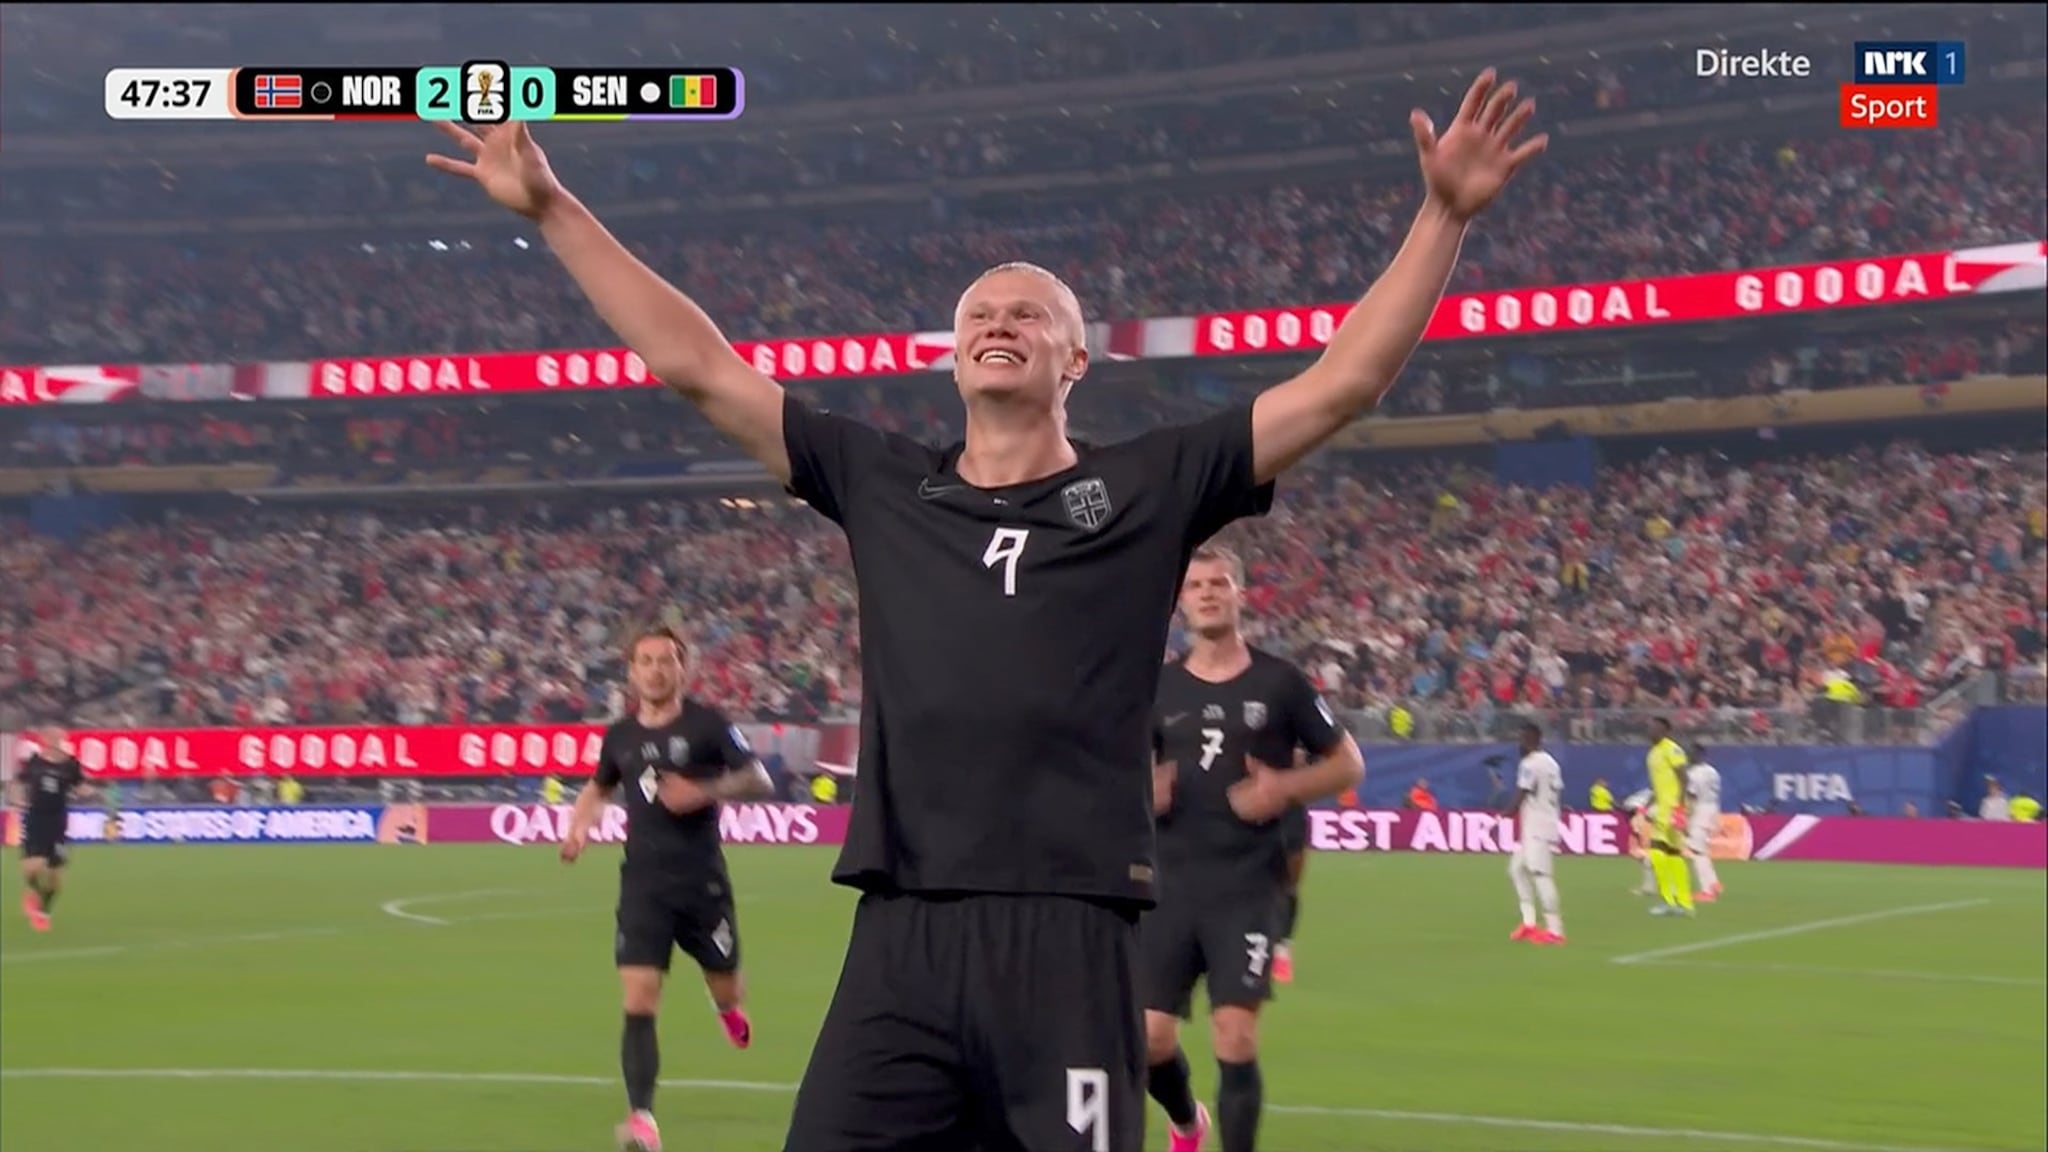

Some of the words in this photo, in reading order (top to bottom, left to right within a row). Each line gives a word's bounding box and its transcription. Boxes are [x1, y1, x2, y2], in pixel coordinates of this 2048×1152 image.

[1735, 254, 1972, 311] GOOOAL
[1460, 283, 1670, 332] GOOOAL
[1209, 309, 1335, 351] GOOO
[322, 358, 491, 394] GOOOAL
[536, 351, 648, 387] GOOO
[752, 337, 930, 377] GOOOAL
[982, 527, 1030, 596] 9
[237, 732, 419, 770] GOOOAL
[458, 731, 603, 768] GOOOA
[1199, 727, 1225, 772] 7
[1772, 772, 1854, 802] FIFA
[490, 804, 628, 845] QATR
[1308, 810, 1401, 850] EST
[1410, 811, 1620, 855] AIRLNE
[1245, 932, 1270, 977] 7
[1065, 1067, 1110, 1152] 9
